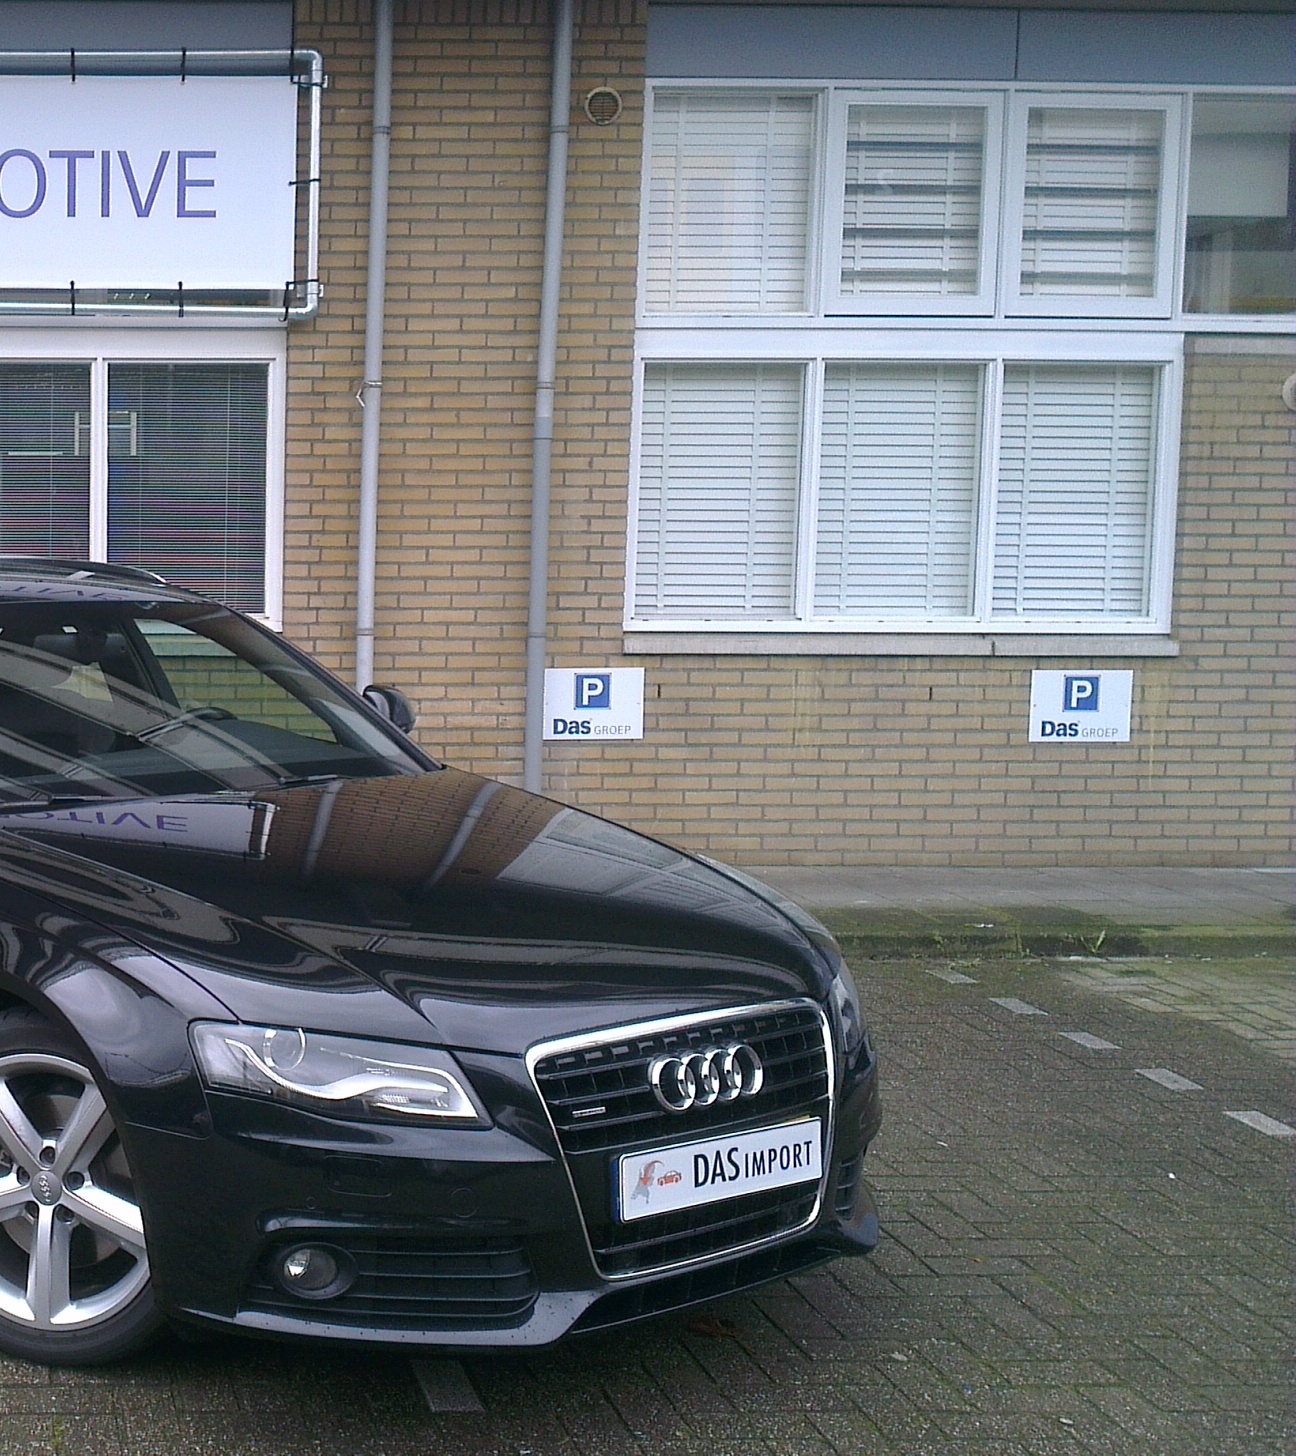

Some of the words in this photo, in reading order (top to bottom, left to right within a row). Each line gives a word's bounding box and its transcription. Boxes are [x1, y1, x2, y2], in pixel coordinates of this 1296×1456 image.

[582, 678, 604, 706] P
[1071, 680, 1093, 708] P
[553, 718, 591, 735] Das
[593, 725, 632, 735] GROEP
[1041, 720, 1079, 737] Das
[1081, 727, 1118, 738] GROEP
[693, 1147, 741, 1188] DAS
[745, 1140, 812, 1178] IMPORT
